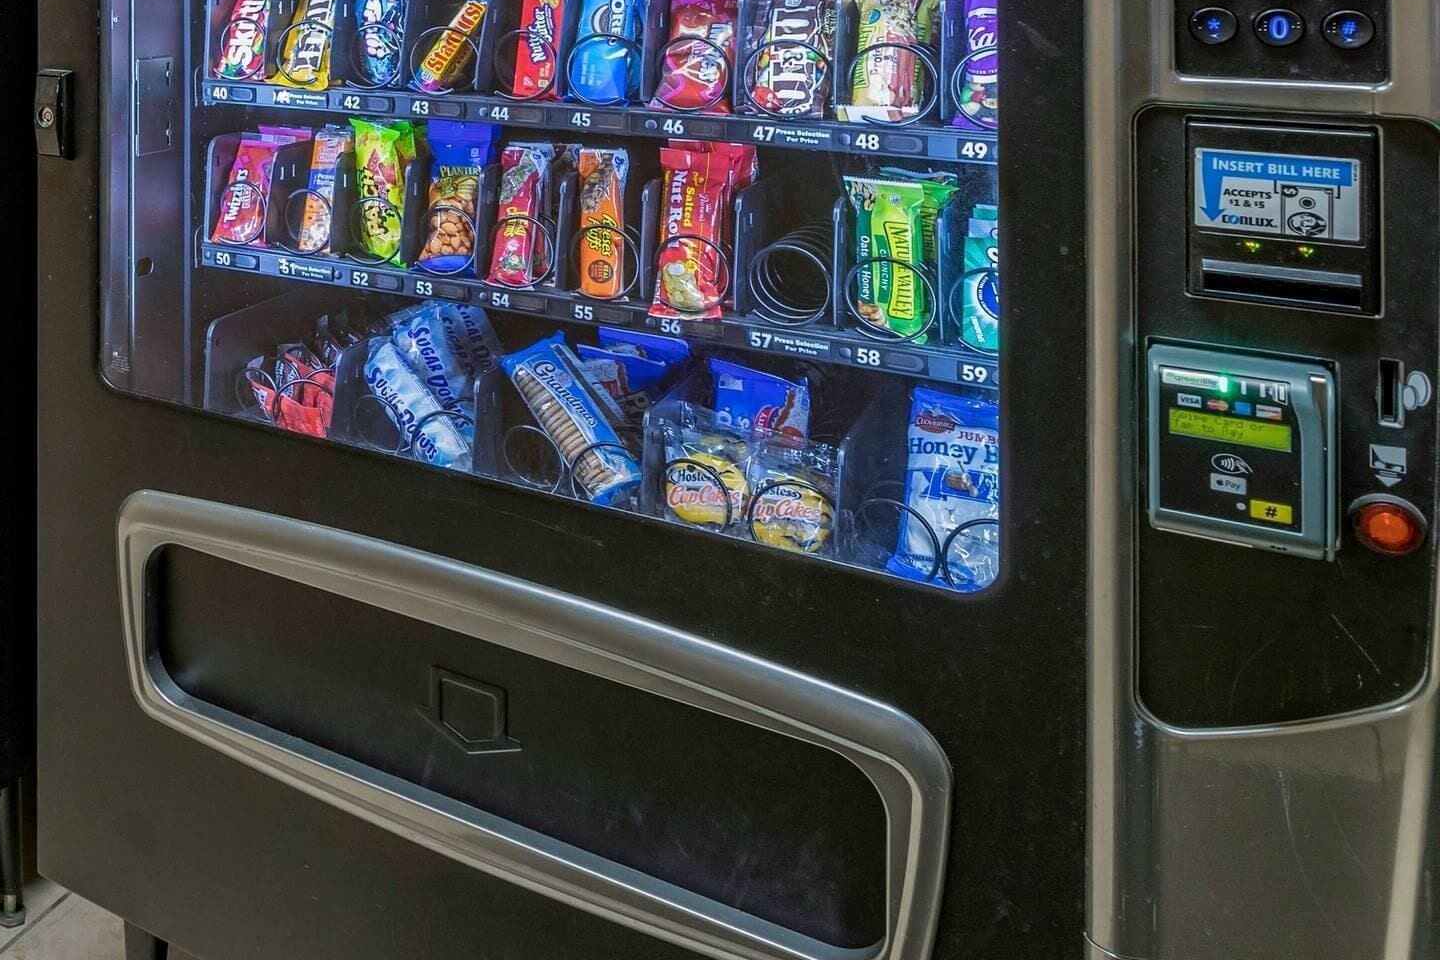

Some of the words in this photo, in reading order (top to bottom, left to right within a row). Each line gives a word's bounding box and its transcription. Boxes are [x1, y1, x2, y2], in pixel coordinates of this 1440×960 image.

[1271, 16, 1289, 39] 0
[1342, 21, 1356, 35] #
[213, 88, 227, 100] 40
[344, 96, 360, 109] 42
[412, 100, 429, 115] 43
[491, 107, 509, 121] 44
[572, 113, 591, 127] 45
[663, 119, 684, 134] 46
[753, 125, 775, 141] 47
[856, 134, 880, 150] 48
[962, 143, 987, 158] 49
[1213, 157, 1263, 172] INSERT
[1268, 163, 1298, 176] BILL
[1302, 168, 1340, 179] HERE
[671, 170, 687, 203] Nut
[1223, 188, 1272, 199] ACCEPTS
[683, 186, 697, 228] Salted
[1243, 200, 1252, 208] &
[1254, 201, 1265, 209] $5
[860, 235, 870, 257] Oats
[216, 254, 230, 265] 50
[880, 248, 888, 291] CUNCHY
[353, 273, 368, 285] 52
[860, 270, 871, 300] Honey
[416, 283, 432, 295] 53
[891, 274, 912, 316] VALLEY
[492, 293, 509, 307] 54
[574, 305, 593, 320] 55
[661, 320, 681, 334] 56
[750, 333, 772, 349] 57
[857, 350, 881, 366] 58
[962, 366, 987, 383] 59
[1173, 373, 1217, 387] greenlite
[1180, 396, 1200, 405] VISA
[1173, 411, 1208, 425] Swipe
[1214, 415, 1244, 428] Card
[1252, 424, 1265, 432] or
[1202, 424, 1215, 433] to
[1222, 427, 1244, 439] Pay
[909, 437, 978, 465] Honey
[1224, 480, 1241, 490] Pay
[1264, 506, 1278, 519] #
